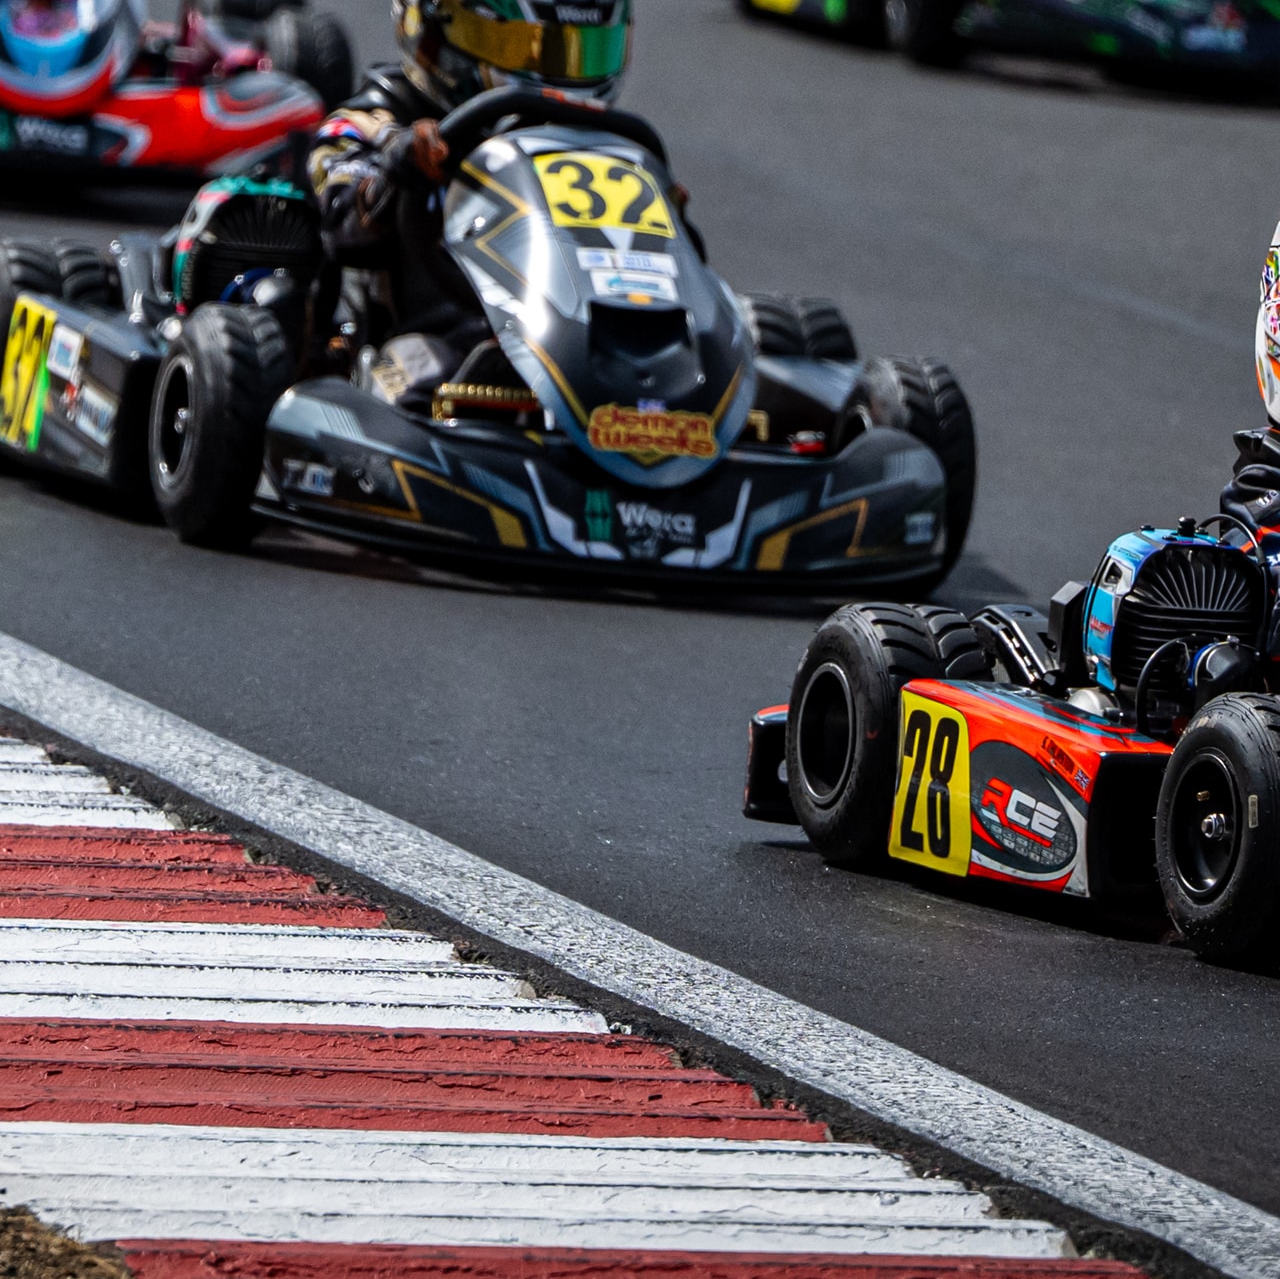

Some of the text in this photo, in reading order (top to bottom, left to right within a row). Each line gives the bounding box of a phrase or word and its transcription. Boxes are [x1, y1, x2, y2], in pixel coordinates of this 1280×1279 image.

[547, 160, 667, 229] 32
[616, 501, 696, 534] Wera
[901, 709, 960, 858] 28
